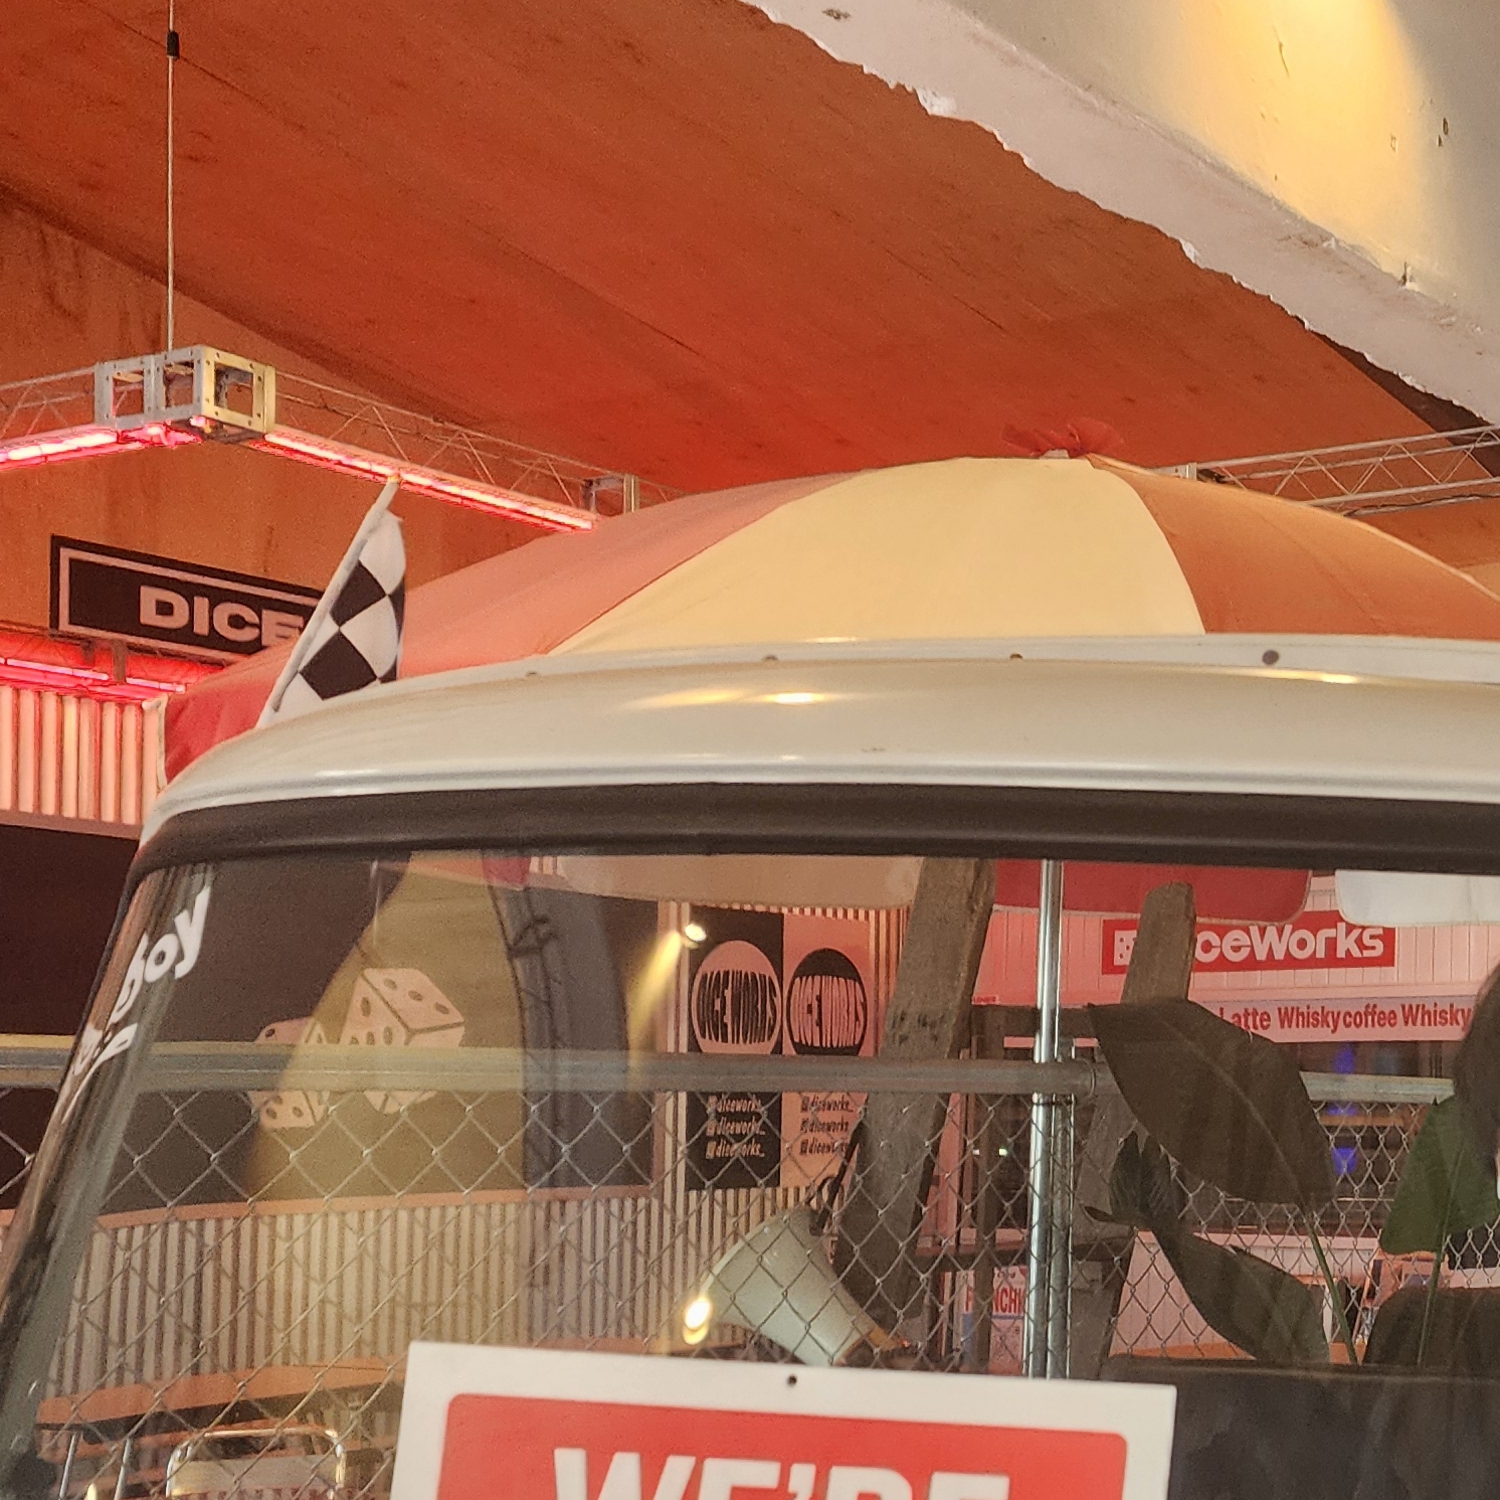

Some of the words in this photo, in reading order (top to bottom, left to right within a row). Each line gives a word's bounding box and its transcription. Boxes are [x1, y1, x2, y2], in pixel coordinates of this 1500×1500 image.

[139, 585, 304, 648] DICE
[1194, 922, 1384, 963] ceWorks
[1277, 1006, 1342, 1034] Whisky
[1342, 1004, 1397, 1029] coffee
